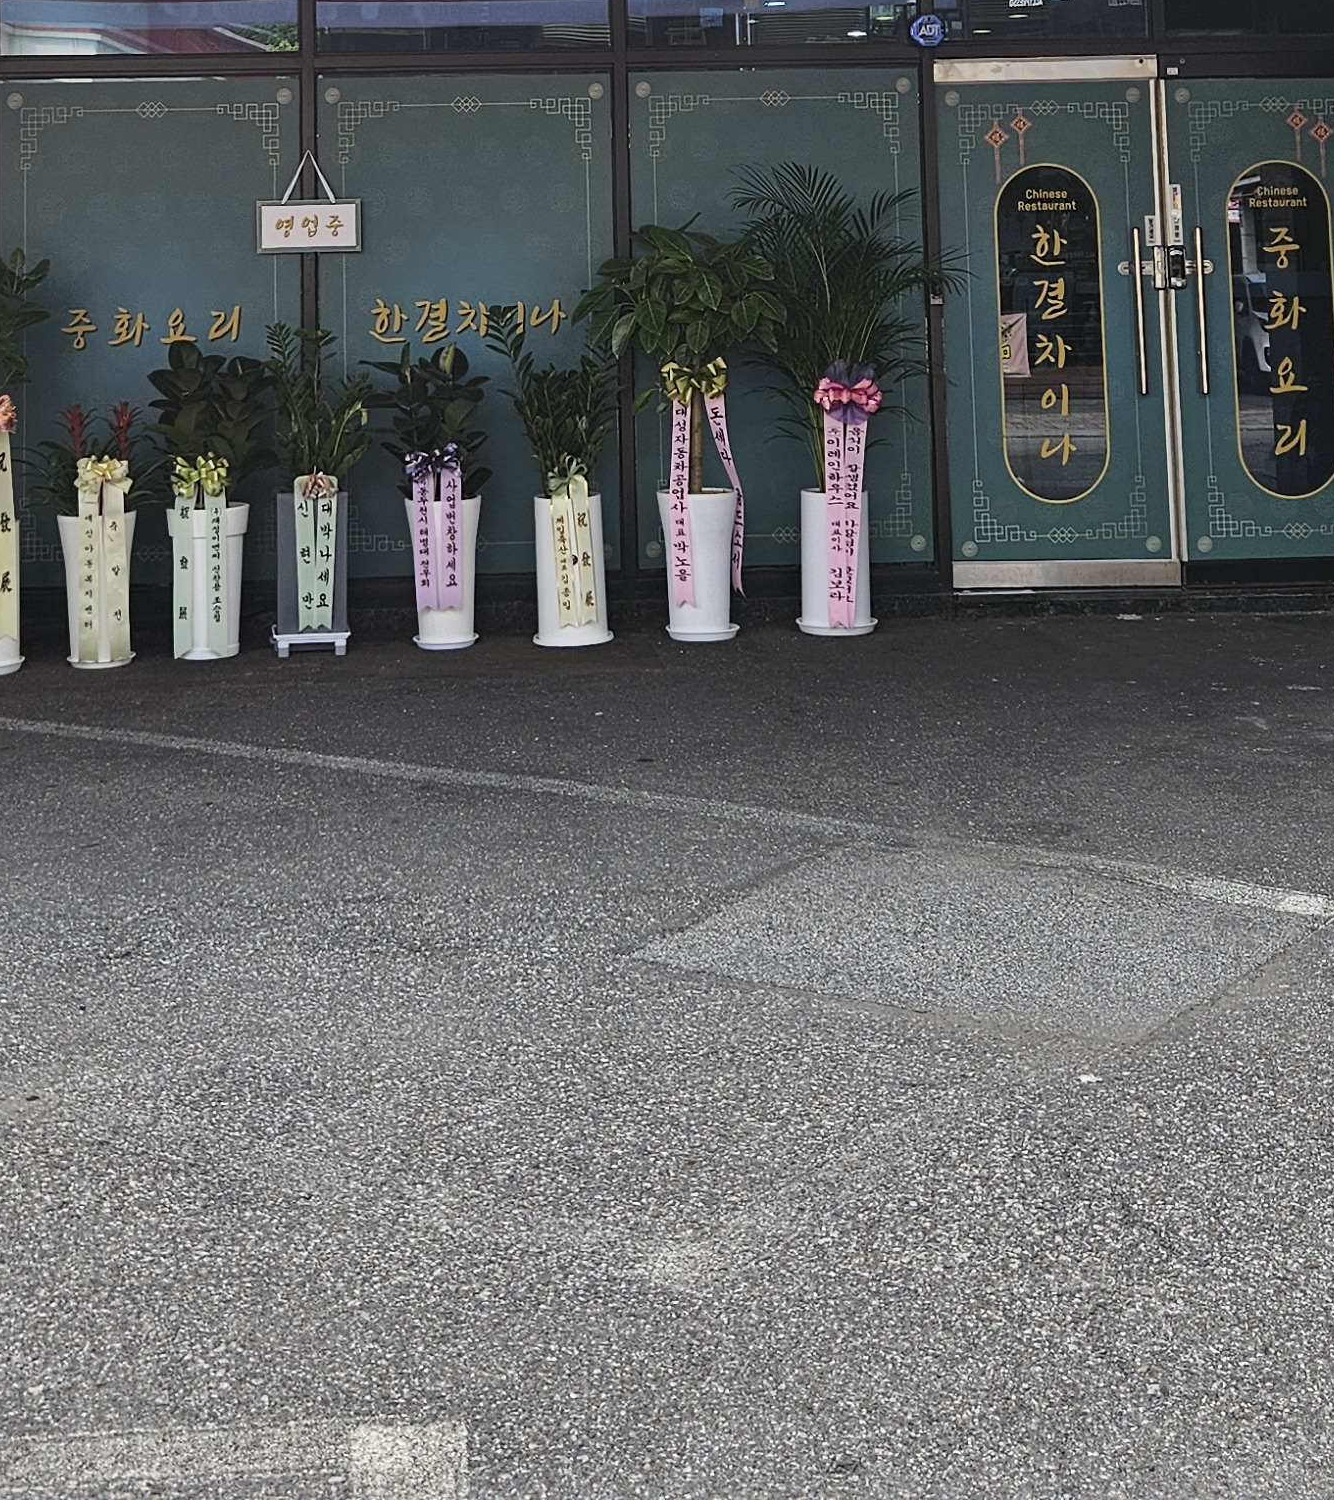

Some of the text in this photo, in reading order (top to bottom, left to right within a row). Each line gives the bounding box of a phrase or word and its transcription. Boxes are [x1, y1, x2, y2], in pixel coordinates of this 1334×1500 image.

[919, 24, 941, 37] ADT
[1025, 189, 1068, 199] Chinese
[1256, 186, 1299, 196] Chinese
[1017, 200, 1077, 212] Restaurant
[1249, 197, 1307, 208] Restaurant
[275, 214, 345, 238] 영업중
[61, 306, 242, 349] 중화요리
[1030, 223, 1077, 467] 한결차이나
[1262, 226, 1308, 457] 중화요리
[675, 518, 686, 537] 대표
[316, 500, 333, 609] 대박나세요
